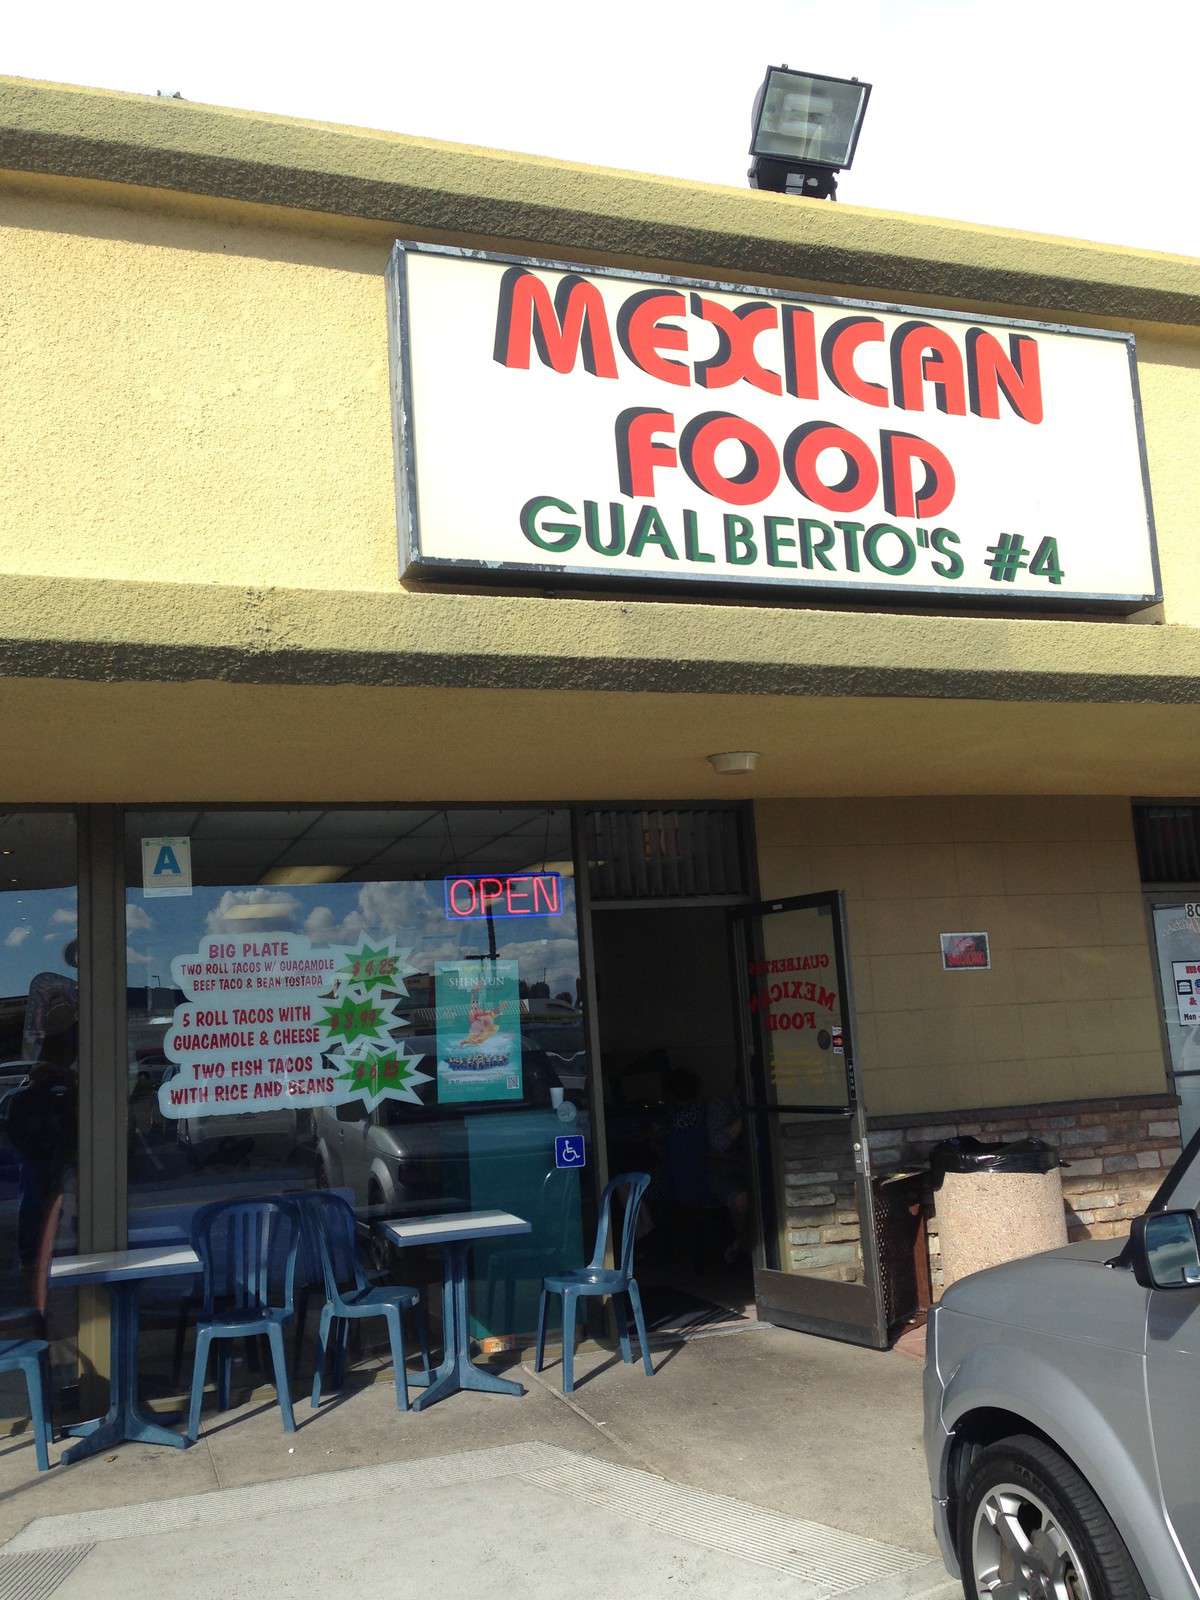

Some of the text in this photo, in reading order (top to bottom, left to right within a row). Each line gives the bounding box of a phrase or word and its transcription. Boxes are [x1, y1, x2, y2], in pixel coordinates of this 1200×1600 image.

[492, 267, 1043, 424] MEXICAN
[614, 406, 956, 518] FOOD
[983, 532, 1065, 585] #4
[153, 846, 181, 874] A
[450, 877, 558, 916] OPEN
[208, 942, 289, 959] BIG PLATE
[181, 963, 202, 976] TWO
[205, 961, 229, 975] ROLL
[231, 961, 261, 974] TACOS
[279, 959, 335, 971] GUACAMOLE
[193, 975, 324, 992] BEEF TACO & BEAN TOSTADA
[182, 1005, 312, 1027] 5 ROLL TACOS WITH
[173, 1027, 320, 1051] GUACAMOLE & CHEESE
[192, 1055, 313, 1080] TWO FISH TACOS
[170, 1076, 335, 1106] WITH RICE AND BEANS
